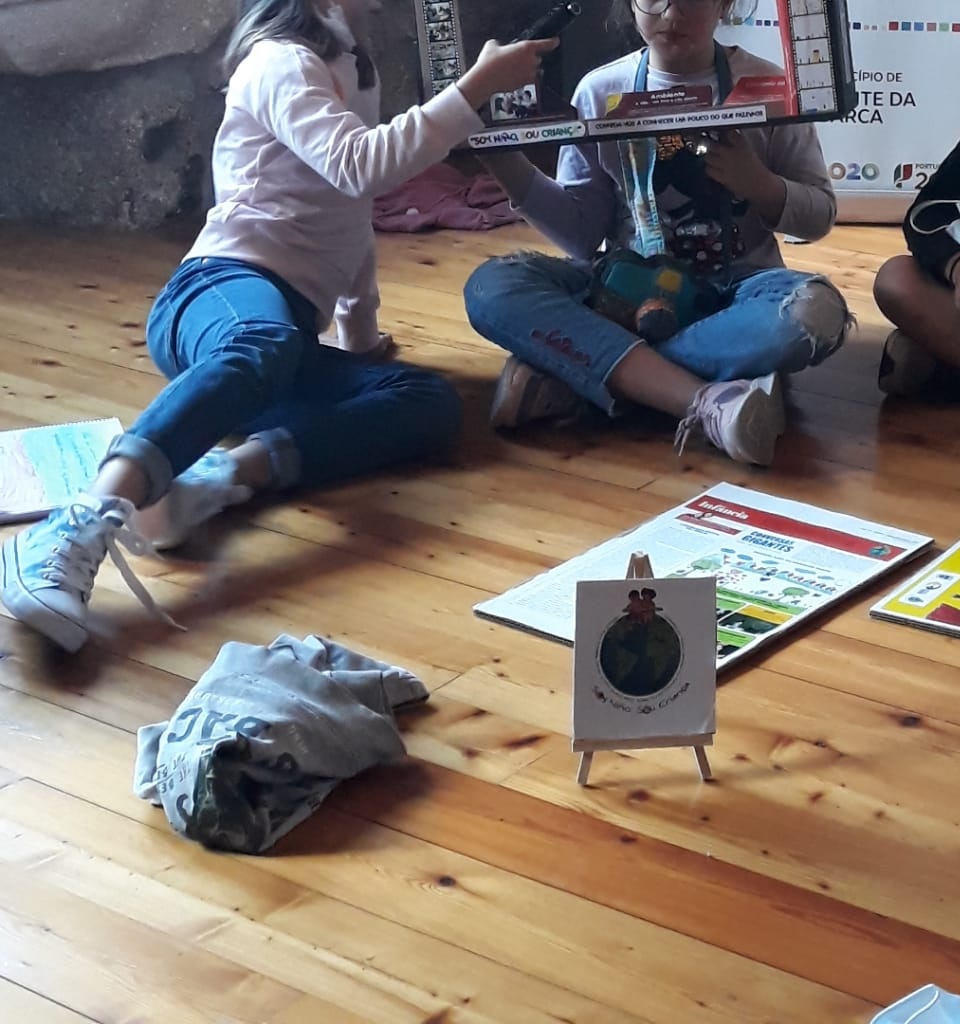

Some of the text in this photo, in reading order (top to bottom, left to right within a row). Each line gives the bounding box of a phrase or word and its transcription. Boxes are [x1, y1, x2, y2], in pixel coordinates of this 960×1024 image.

[886, 72, 904, 83] DE
[890, 91, 916, 107] DA
[722, 112, 734, 120] QUE
[698, 501, 749, 520] Infância
[741, 535, 794, 553] GIGANTES
